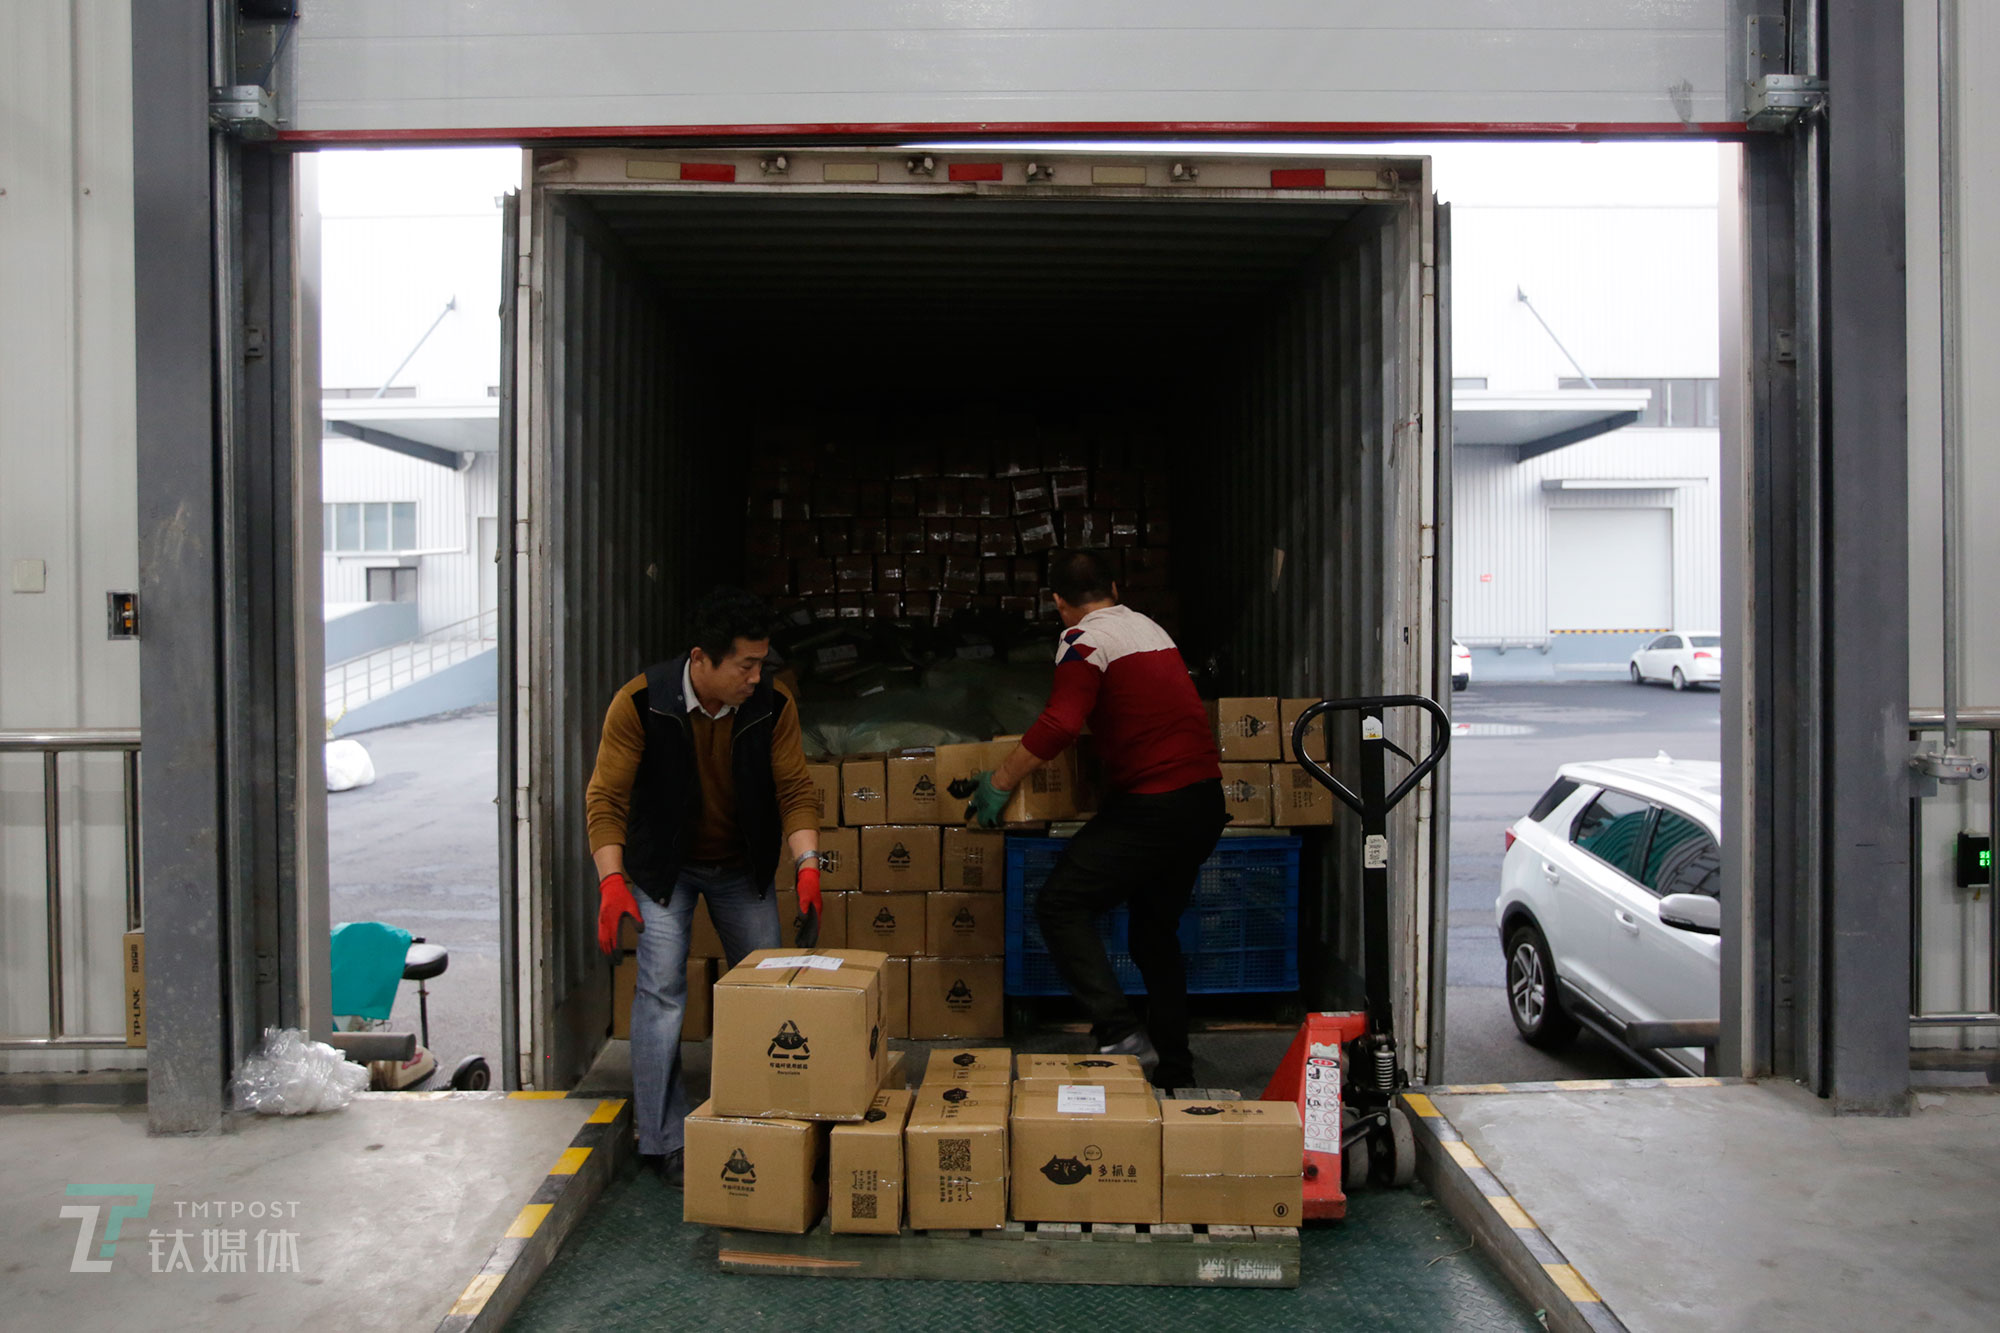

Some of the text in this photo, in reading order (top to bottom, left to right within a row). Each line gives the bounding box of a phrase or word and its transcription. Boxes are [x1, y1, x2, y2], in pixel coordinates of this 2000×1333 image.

[133, 988, 141, 1037] TP-LINK
[1098, 1164, 1137, 1177] 多抓鱼
